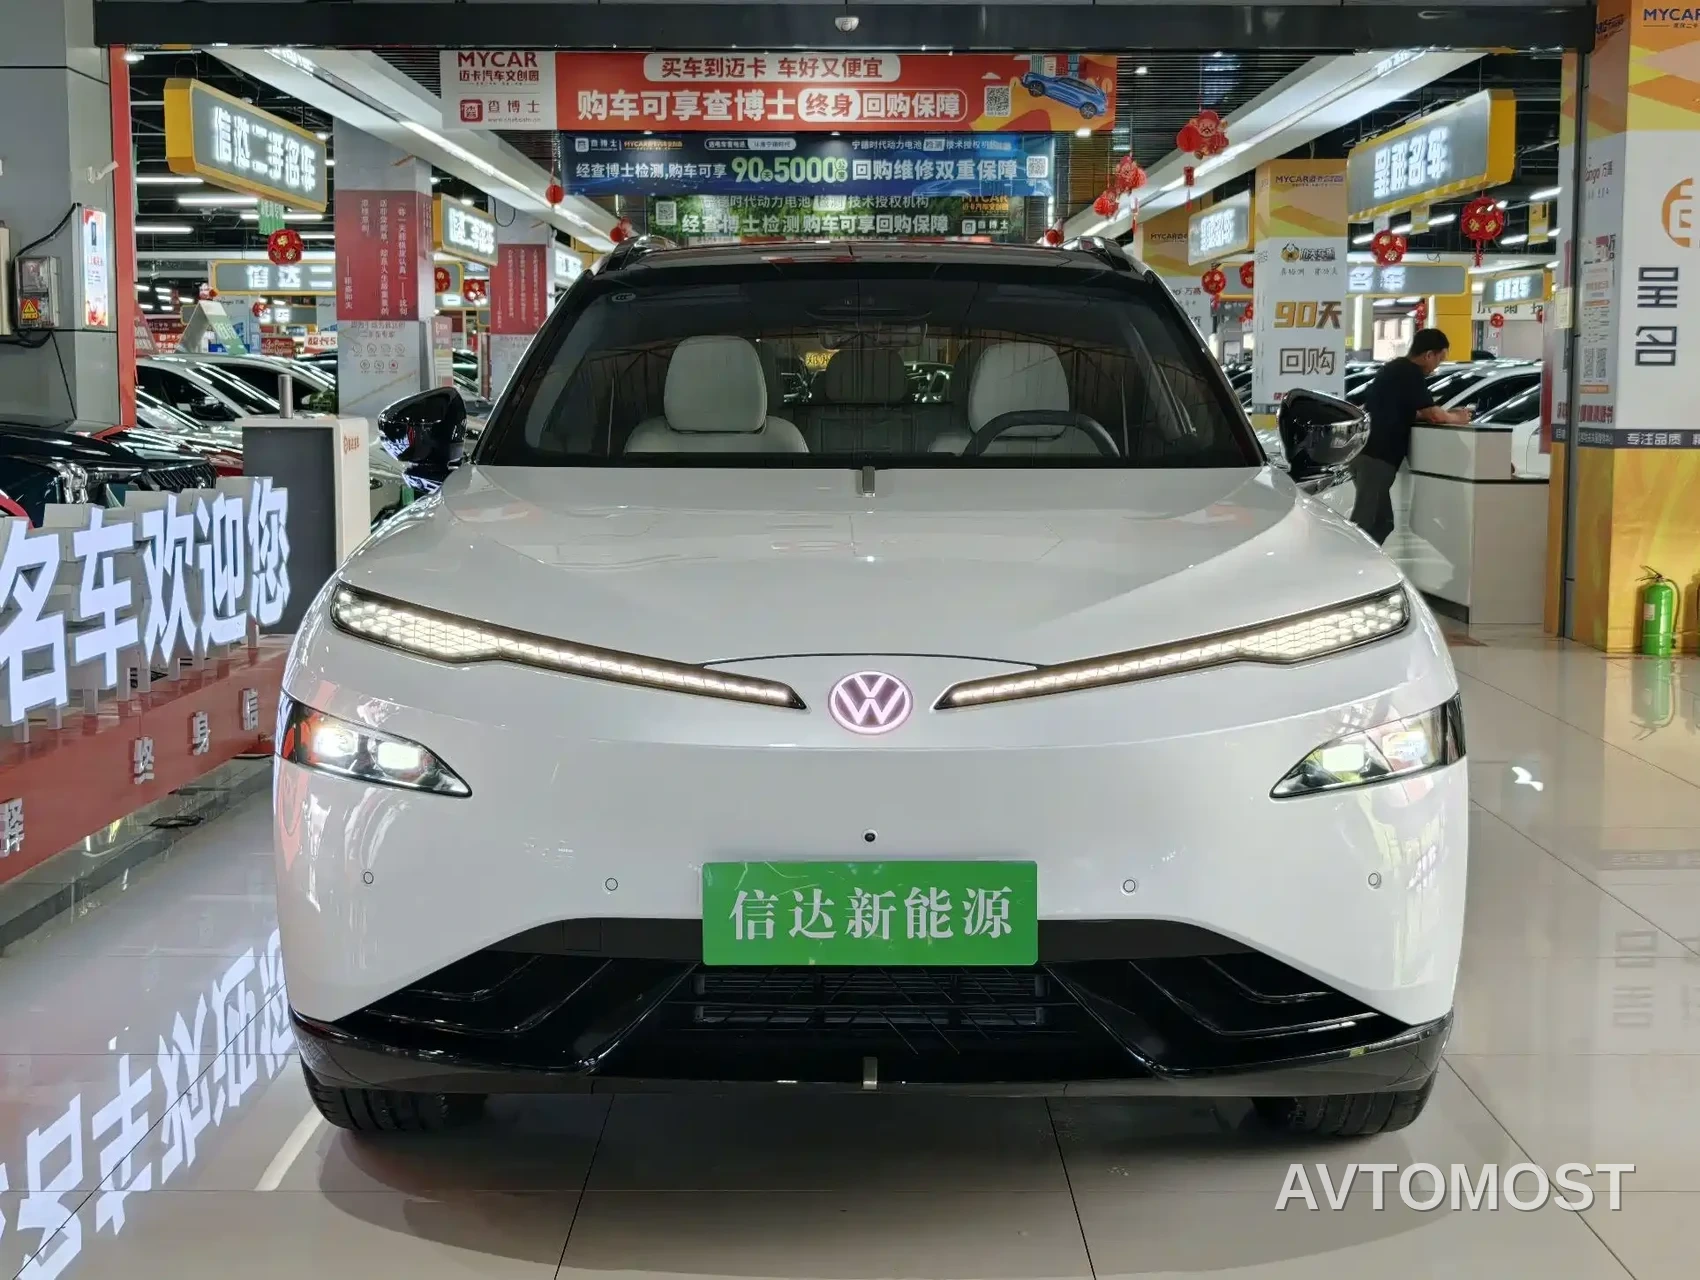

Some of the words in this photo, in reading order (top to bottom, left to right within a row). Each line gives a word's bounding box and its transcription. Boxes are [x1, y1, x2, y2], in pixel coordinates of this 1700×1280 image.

[458, 51, 538, 67] MYCAR
[662, 57, 767, 78] 买车到迈卡
[777, 57, 883, 78] 车好又便宜
[460, 70, 539, 82] 迈卡汽车文创园
[852, 158, 1018, 181] 回购维修双重保障
[1273, 301, 1342, 329] 90天
[1280, 347, 1336, 376] 回购
[1626, 432, 1682, 446] 专注品质
[0, 477, 291, 723] 名车欢迎您
[729, 886, 1013, 941] 信达新能源
